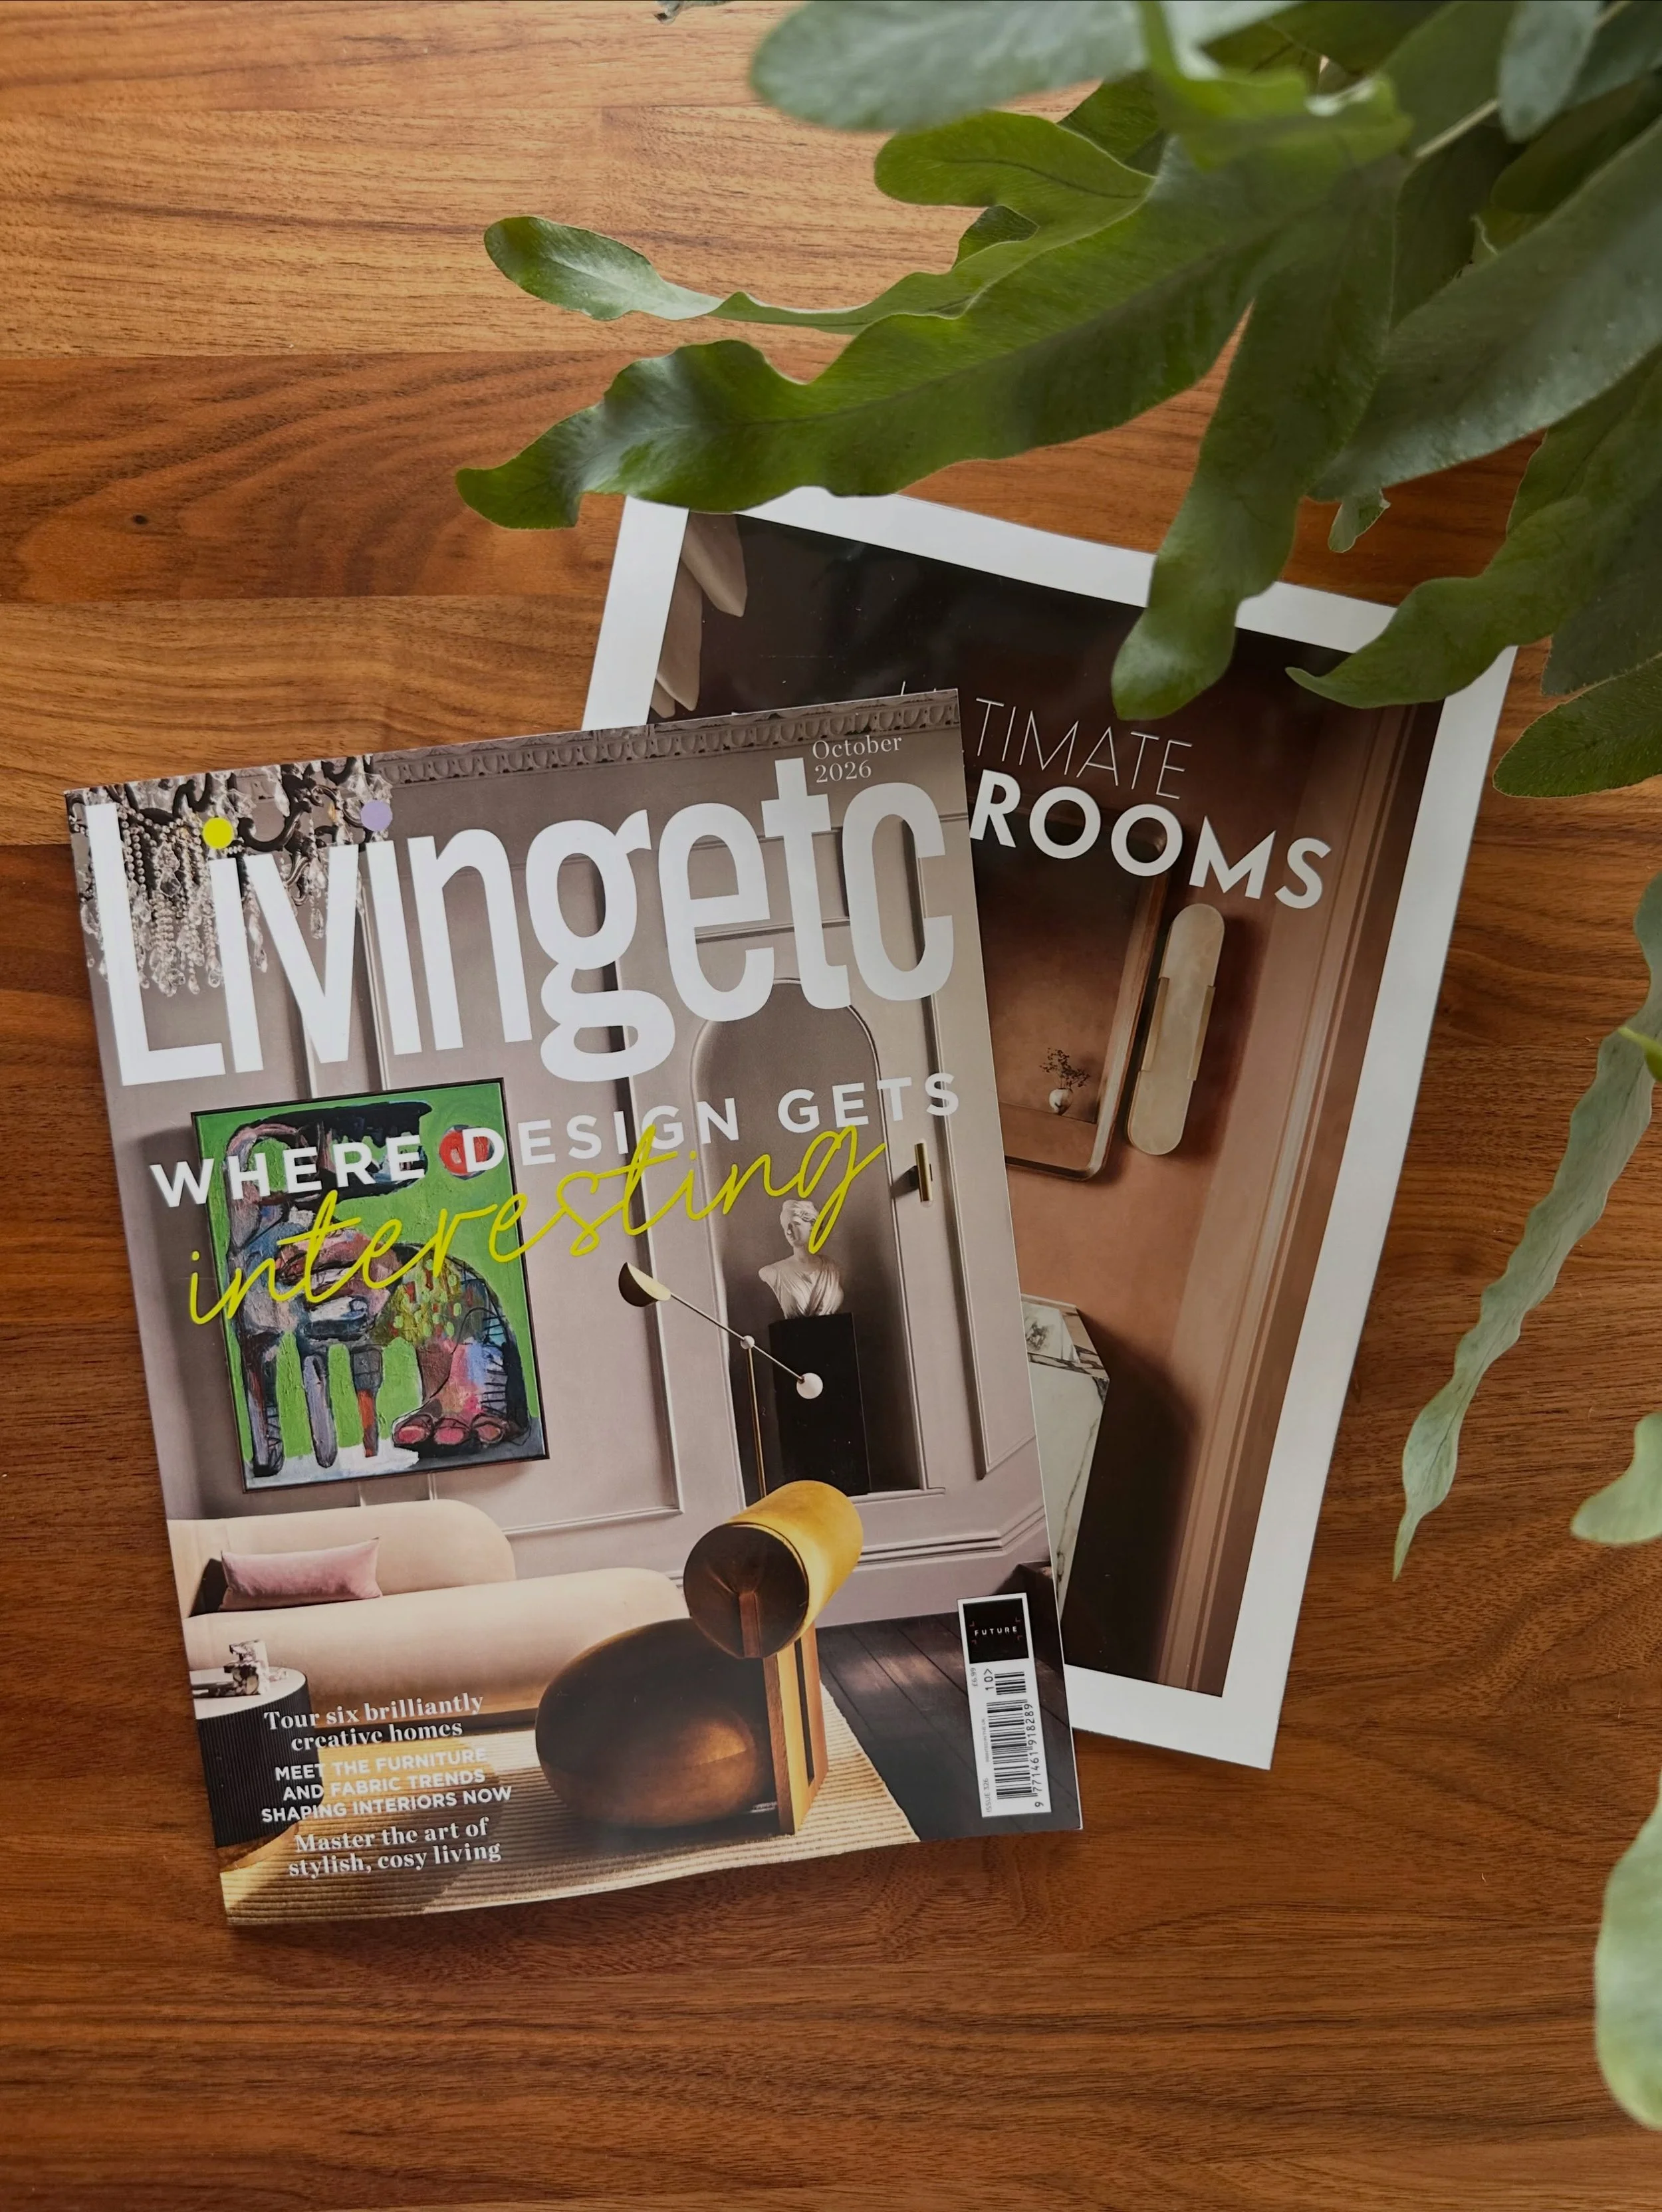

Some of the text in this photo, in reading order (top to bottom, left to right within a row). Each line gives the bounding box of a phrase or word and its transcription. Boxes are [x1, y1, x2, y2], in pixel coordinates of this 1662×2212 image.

[812, 734, 902, 760] October
[814, 759, 872, 783] 2026
[84, 755, 955, 1087] Livingetc
[150, 1072, 960, 1208] WHERE DESIGN GETS
[188, 1125, 886, 1325] interesting
[974, 1626, 1018, 1636] FUTURE
[264, 1692, 484, 1730] Tour six brilliantly
[291, 1720, 463, 1751] creative homes
[275, 1747, 487, 1781] MEET THE FURNITURE
[283, 1769, 486, 1802] AND FABRIC TRENDS
[984, 1790, 993, 1813] ISSUE
[261, 1786, 512, 1823] SHAPING INTERIORS NOW
[295, 1817, 490, 1854] Master the art of
[288, 1843, 502, 1880] stylish, cosy living
